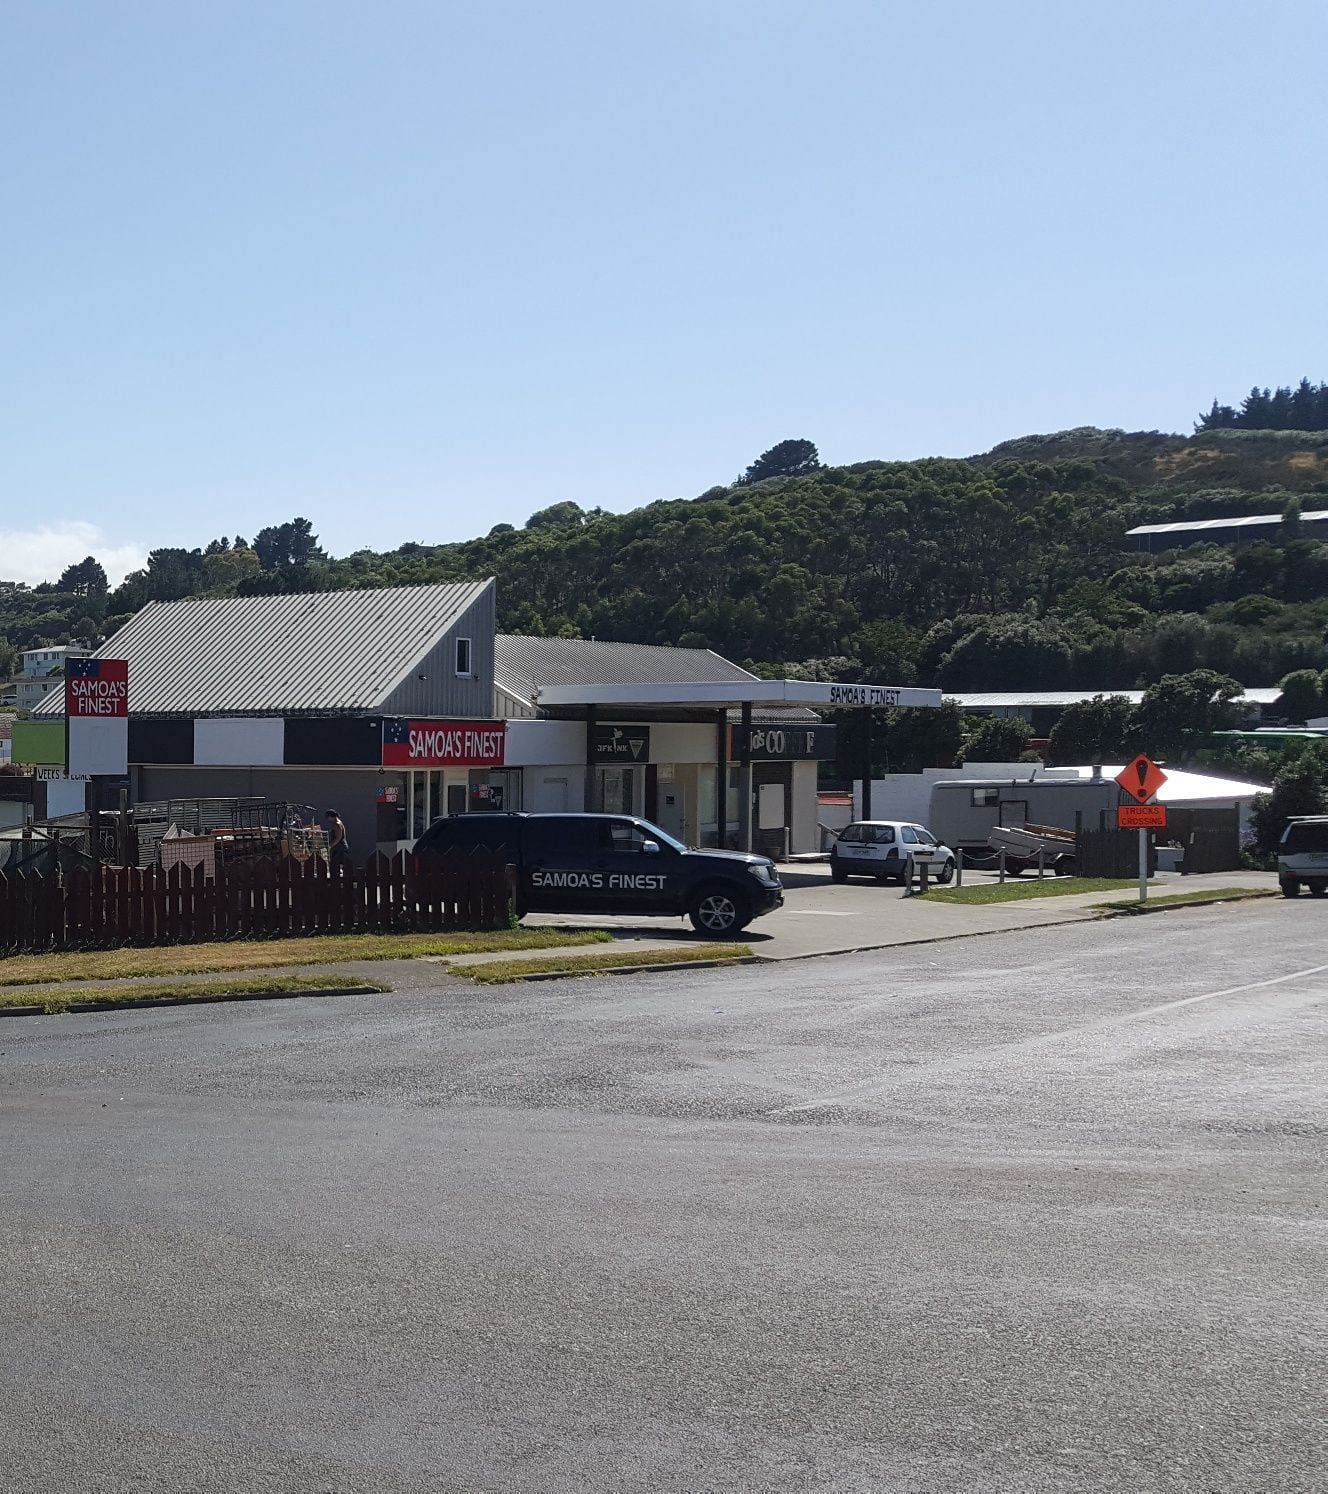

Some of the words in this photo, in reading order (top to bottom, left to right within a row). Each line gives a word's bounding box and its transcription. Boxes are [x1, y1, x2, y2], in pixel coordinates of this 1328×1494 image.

[72, 680, 126, 697] SAMOA'S
[830, 686, 866, 705] SAMOA'S
[870, 689, 901, 706] FINEST
[78, 698, 120, 714] FINEST
[408, 730, 462, 758] SAMOA'S
[464, 731, 504, 758] FINEST
[37, 768, 60, 780] WEEKS
[1125, 807, 1159, 815] TRUCKS
[1122, 817, 1163, 826] CROSSING
[532, 872, 603, 888] SAMOA'S
[609, 874, 667, 890] FINEST
